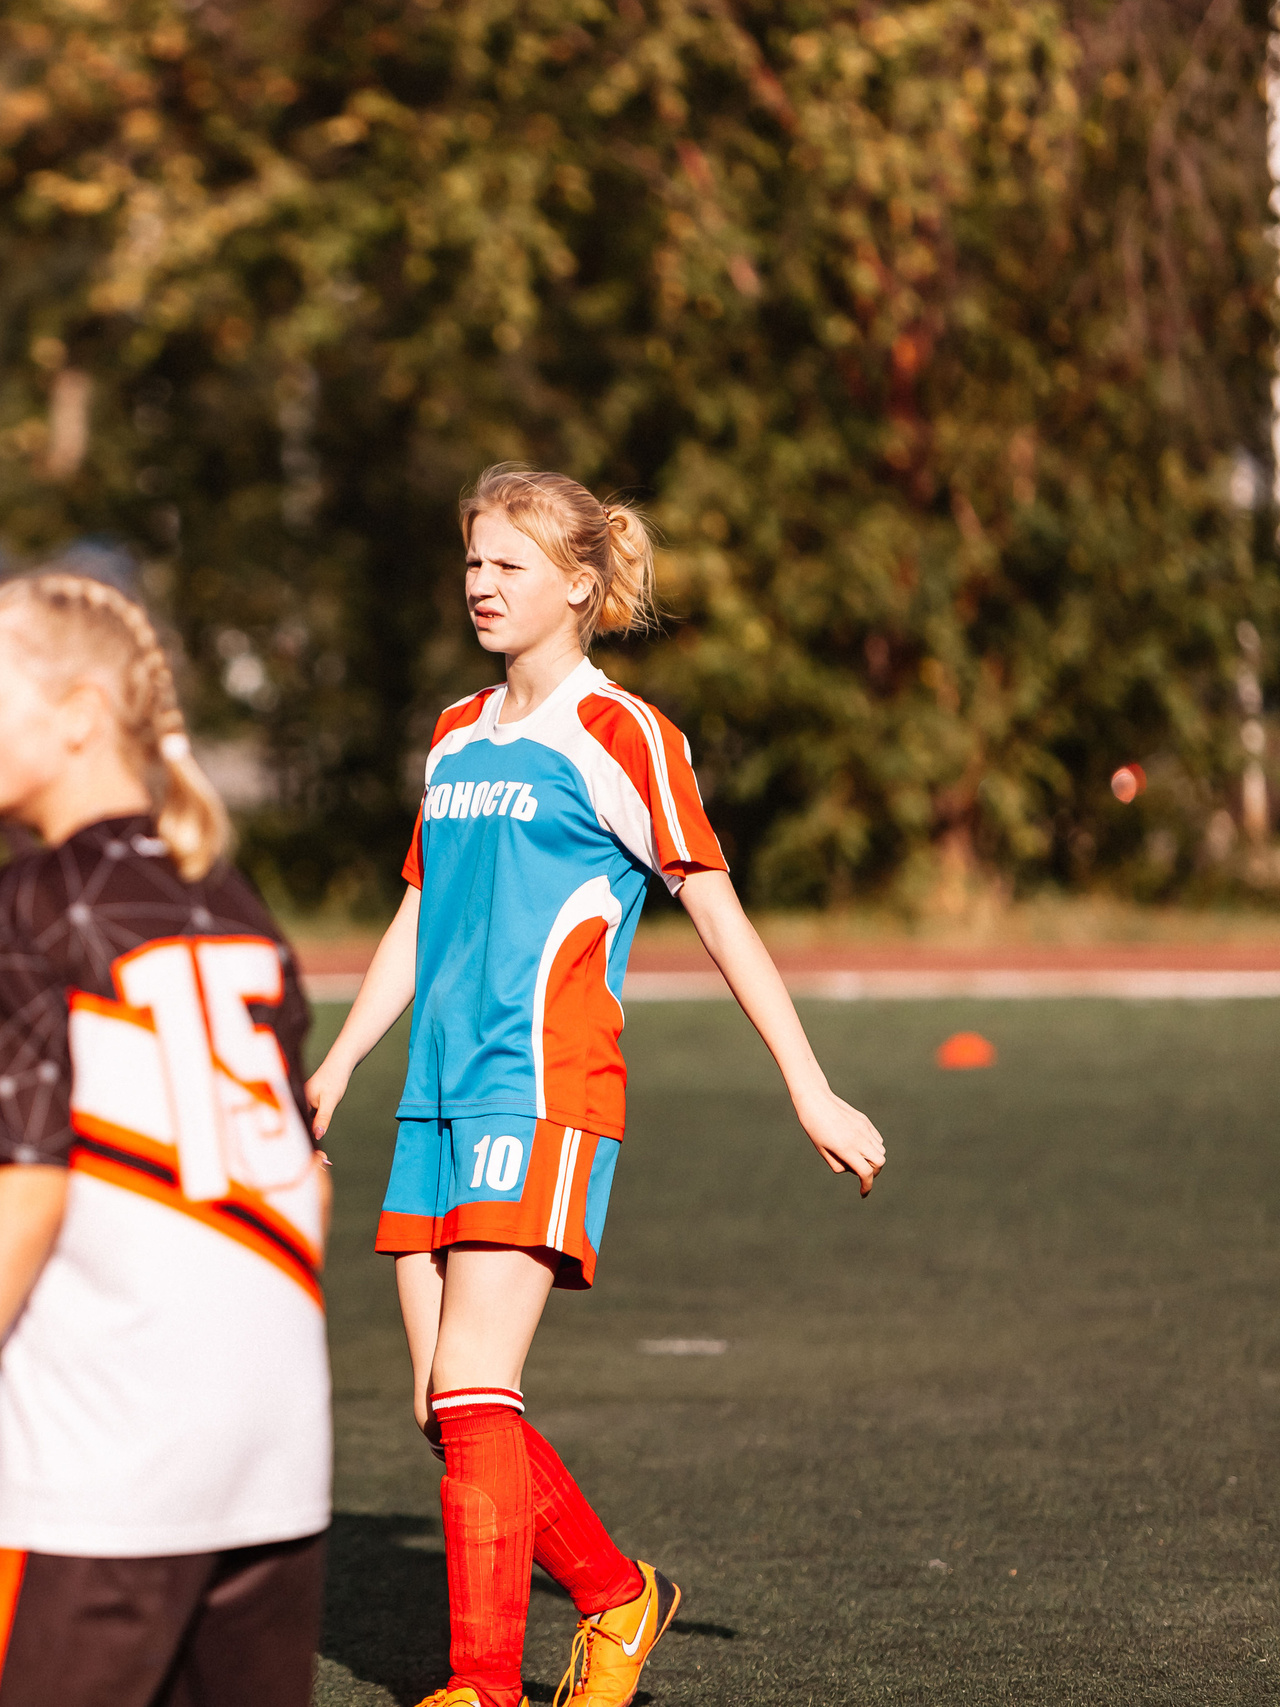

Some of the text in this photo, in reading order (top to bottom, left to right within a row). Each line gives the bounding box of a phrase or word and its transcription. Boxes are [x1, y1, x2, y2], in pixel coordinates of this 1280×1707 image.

[424, 781, 539, 822] ЮНОСТЬ
[111, 934, 312, 1203] 15
[469, 1134, 524, 1191] 10
